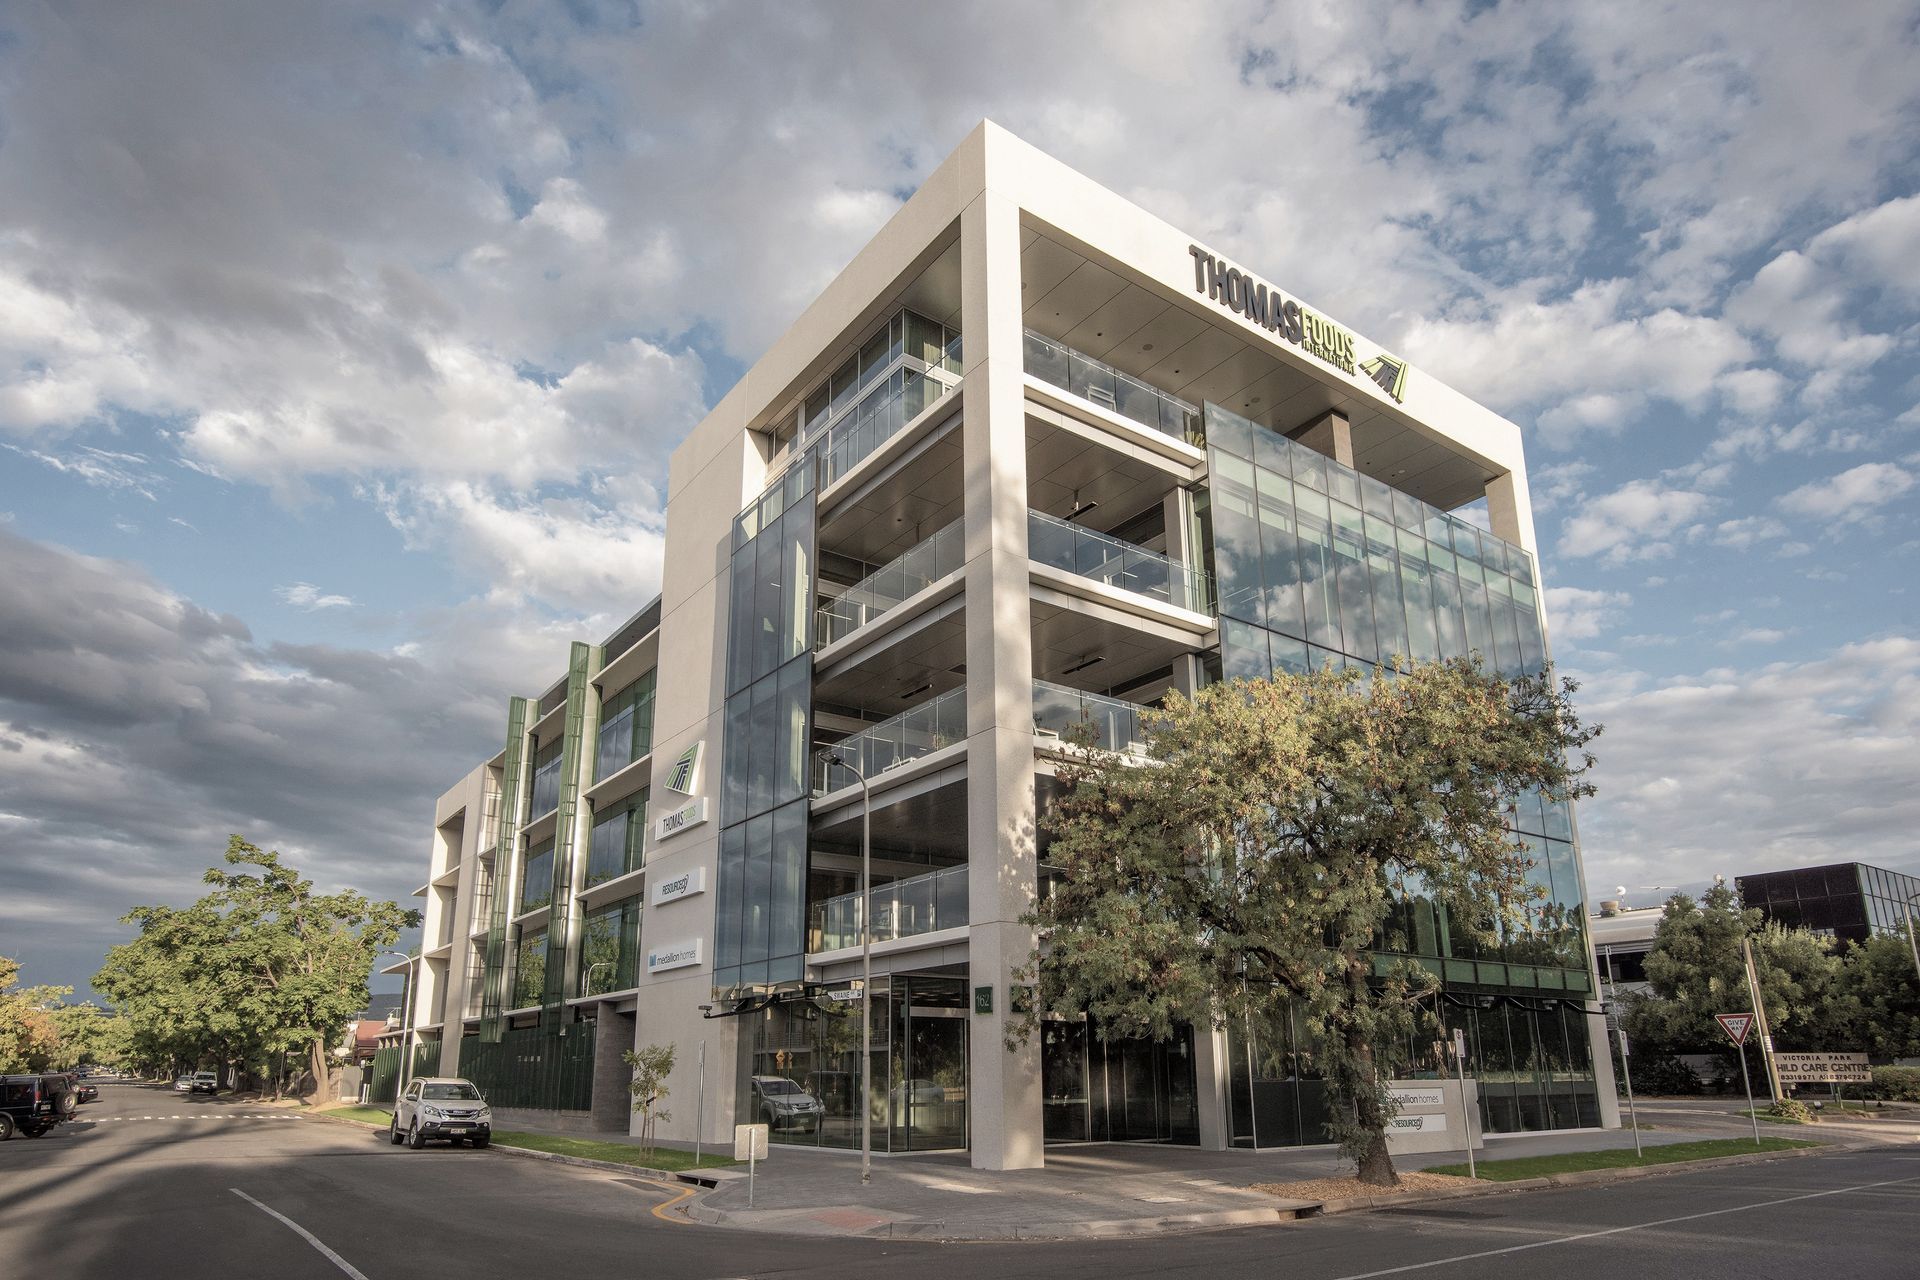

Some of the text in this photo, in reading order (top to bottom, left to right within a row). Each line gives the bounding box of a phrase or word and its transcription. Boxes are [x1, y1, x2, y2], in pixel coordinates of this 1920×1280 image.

[1189, 244, 1357, 364] THOMAS FOODS
[656, 949, 696, 966] medallion homes
[975, 993, 990, 1008] 162
[1776, 1063, 1870, 1072] HILD CARE CENTRE
[1419, 1093, 1439, 1104] homes
